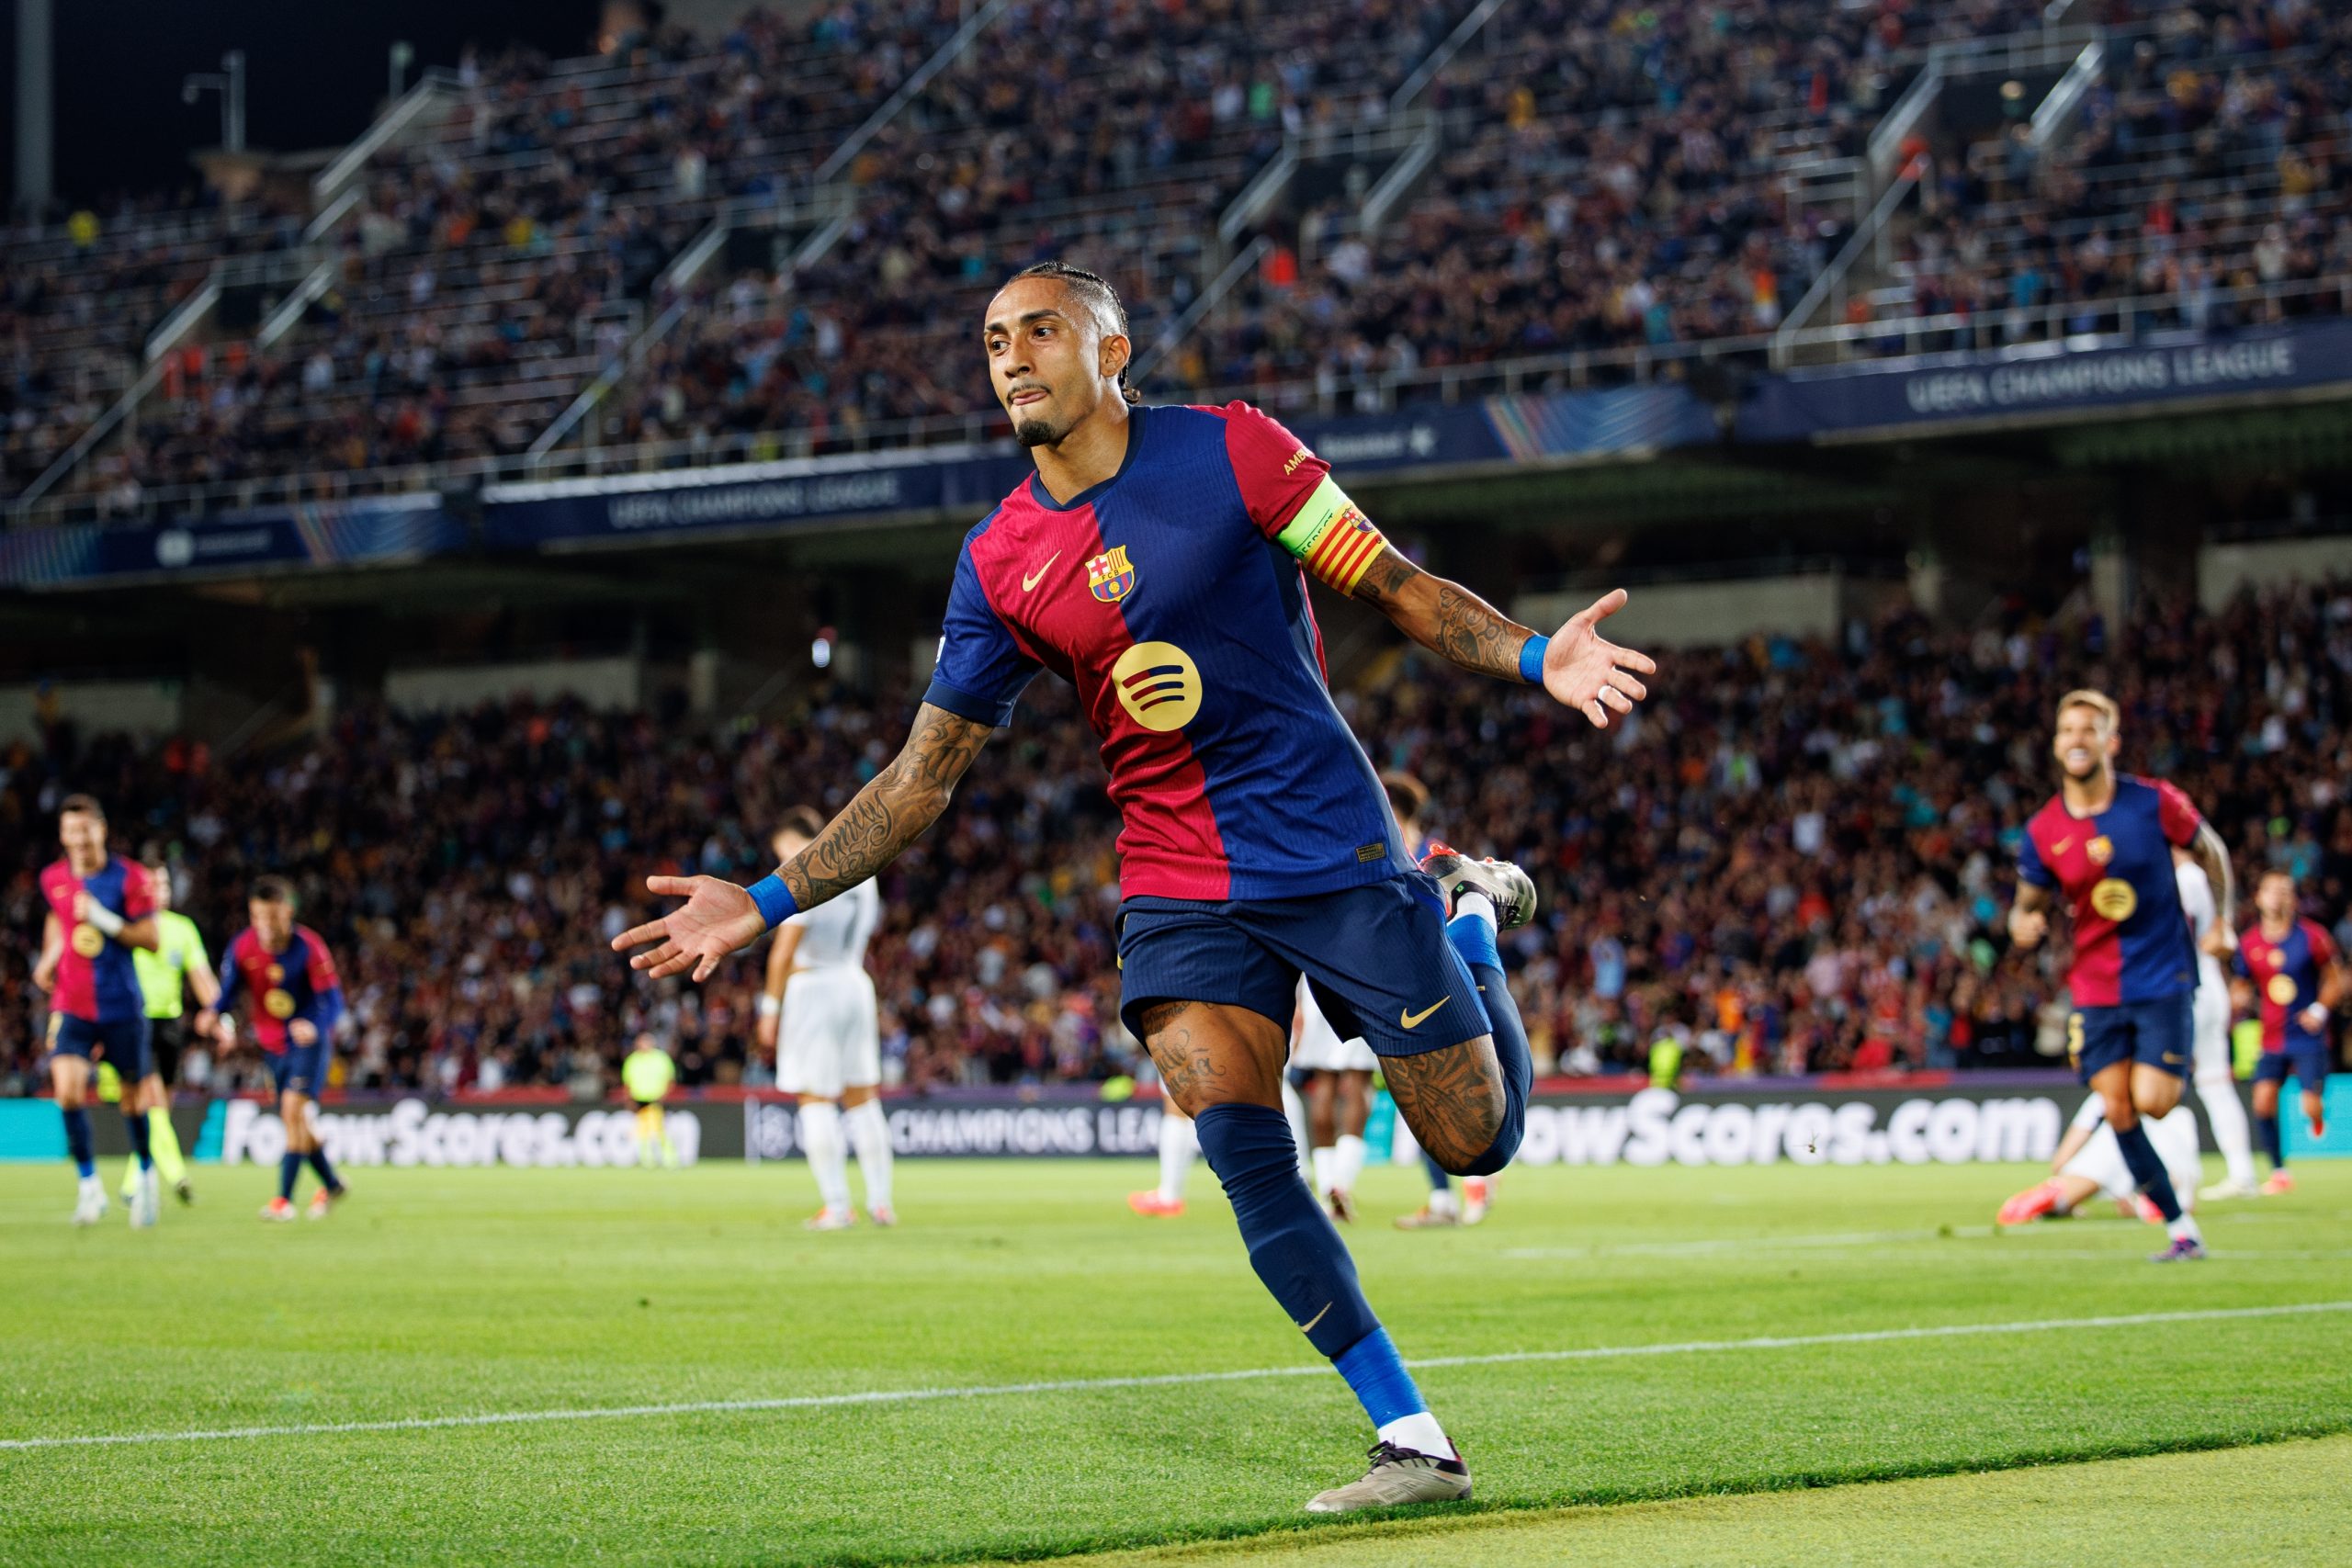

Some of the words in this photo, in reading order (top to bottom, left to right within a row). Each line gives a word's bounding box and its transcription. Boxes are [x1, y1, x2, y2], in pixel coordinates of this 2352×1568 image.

[1906, 372, 1988, 412] UEFA
[1990, 351, 2168, 405] CHAMPIONS
[2173, 336, 2295, 386] LEAGUE
[224, 1098, 702, 1168] FoowScores.co
[888, 1108, 1094, 1154] CHAMPIONS
[1098, 1106, 1161, 1153] LEA
[1519, 1088, 2063, 1167] owScores.com
